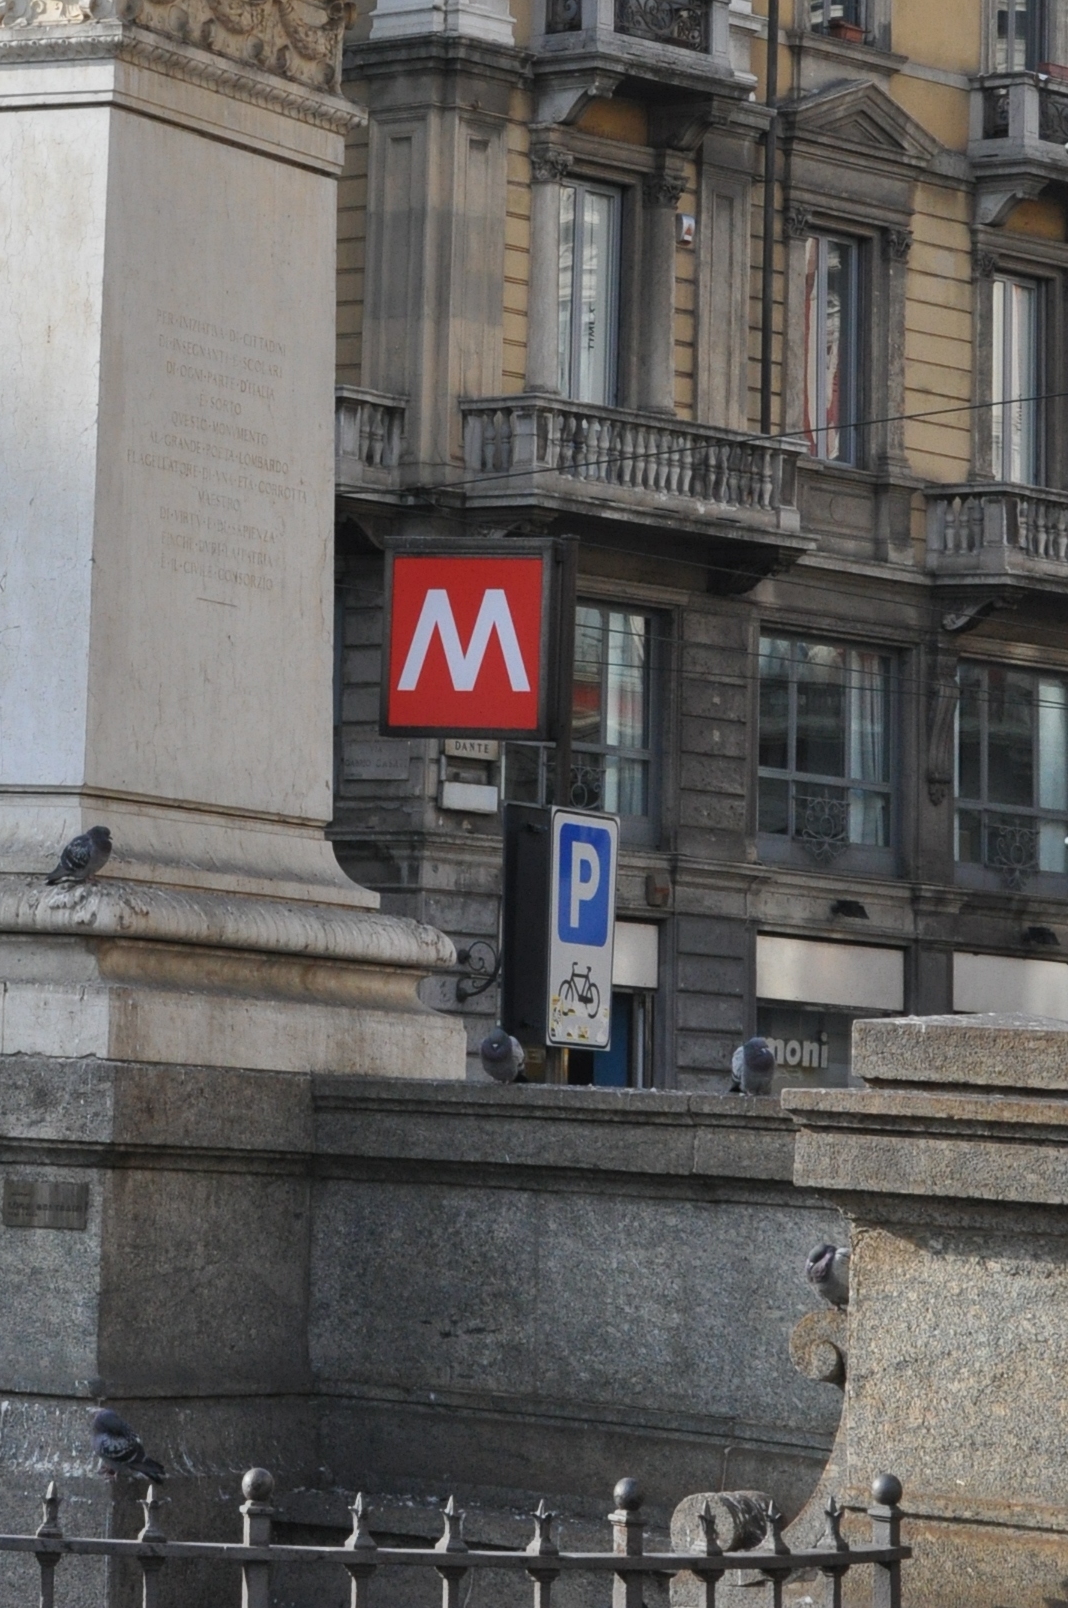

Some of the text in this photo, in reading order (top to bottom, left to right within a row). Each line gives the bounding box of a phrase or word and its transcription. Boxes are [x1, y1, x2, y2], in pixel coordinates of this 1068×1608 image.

[397, 588, 531, 692] M
[454, 740, 490, 754] DANTE
[570, 840, 601, 929] P
